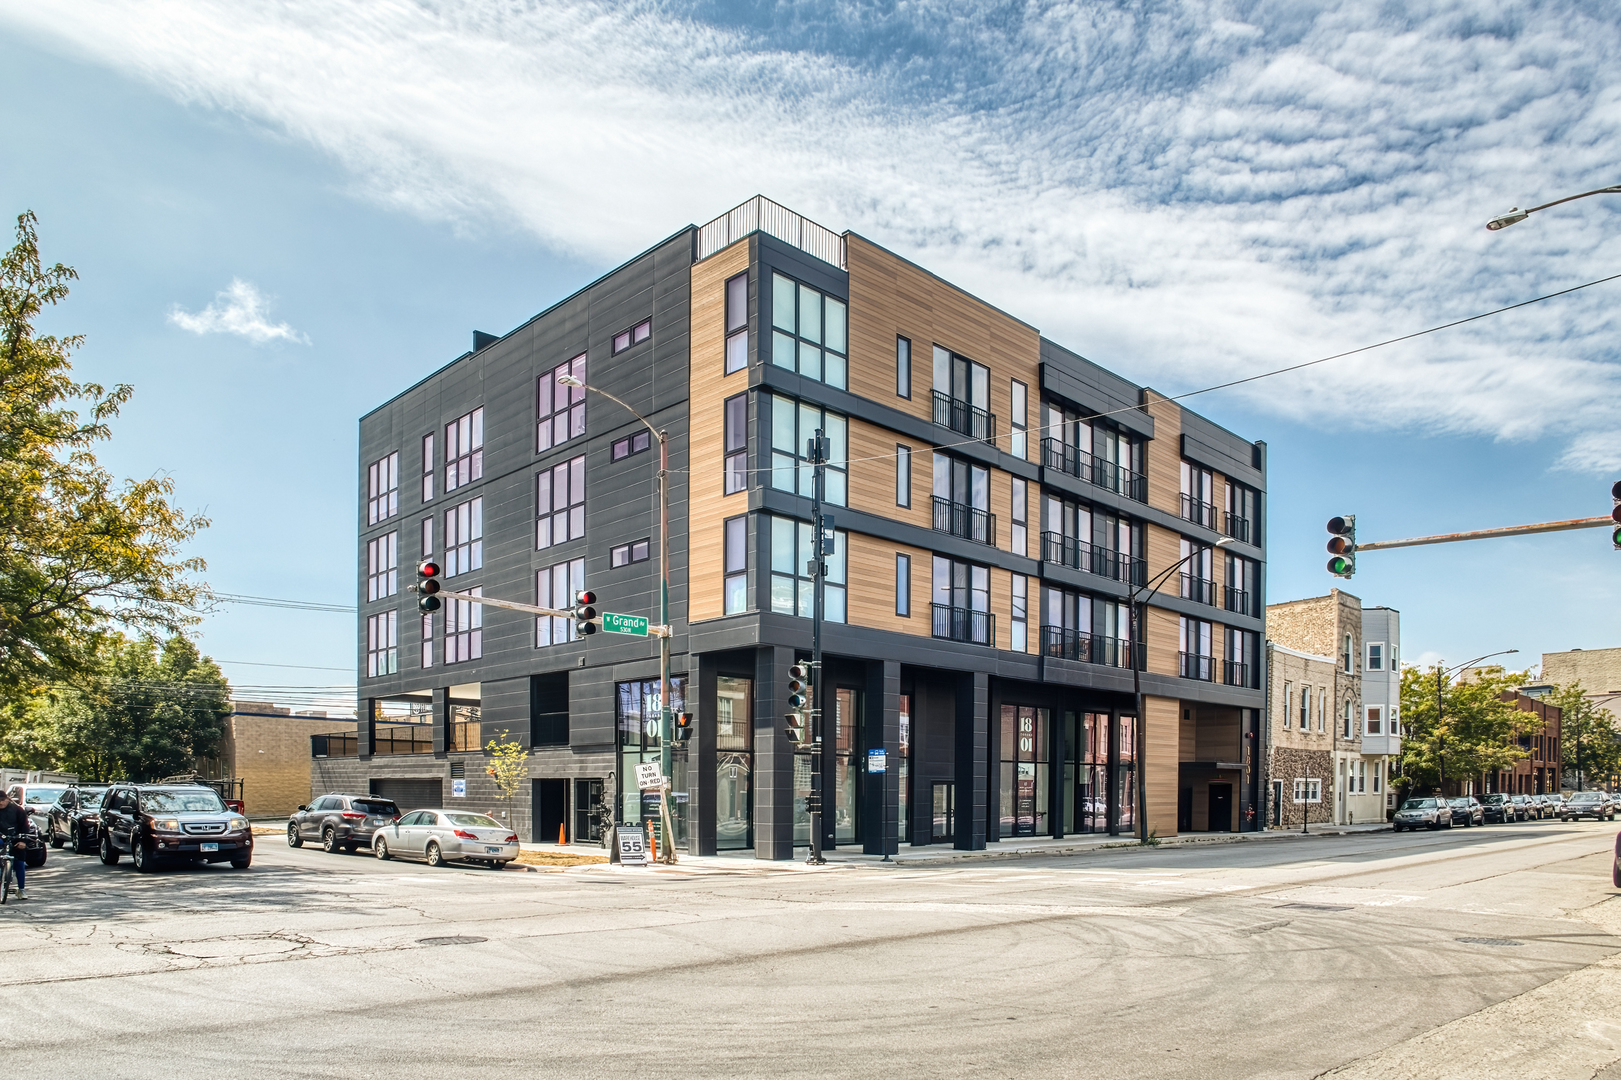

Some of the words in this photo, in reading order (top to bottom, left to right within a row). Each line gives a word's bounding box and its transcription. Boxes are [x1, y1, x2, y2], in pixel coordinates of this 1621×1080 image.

[612, 615, 639, 628] Grand
[1020, 717, 1033, 732] 18
[1020, 737, 1033, 752] 01
[622, 841, 643, 852] 55
